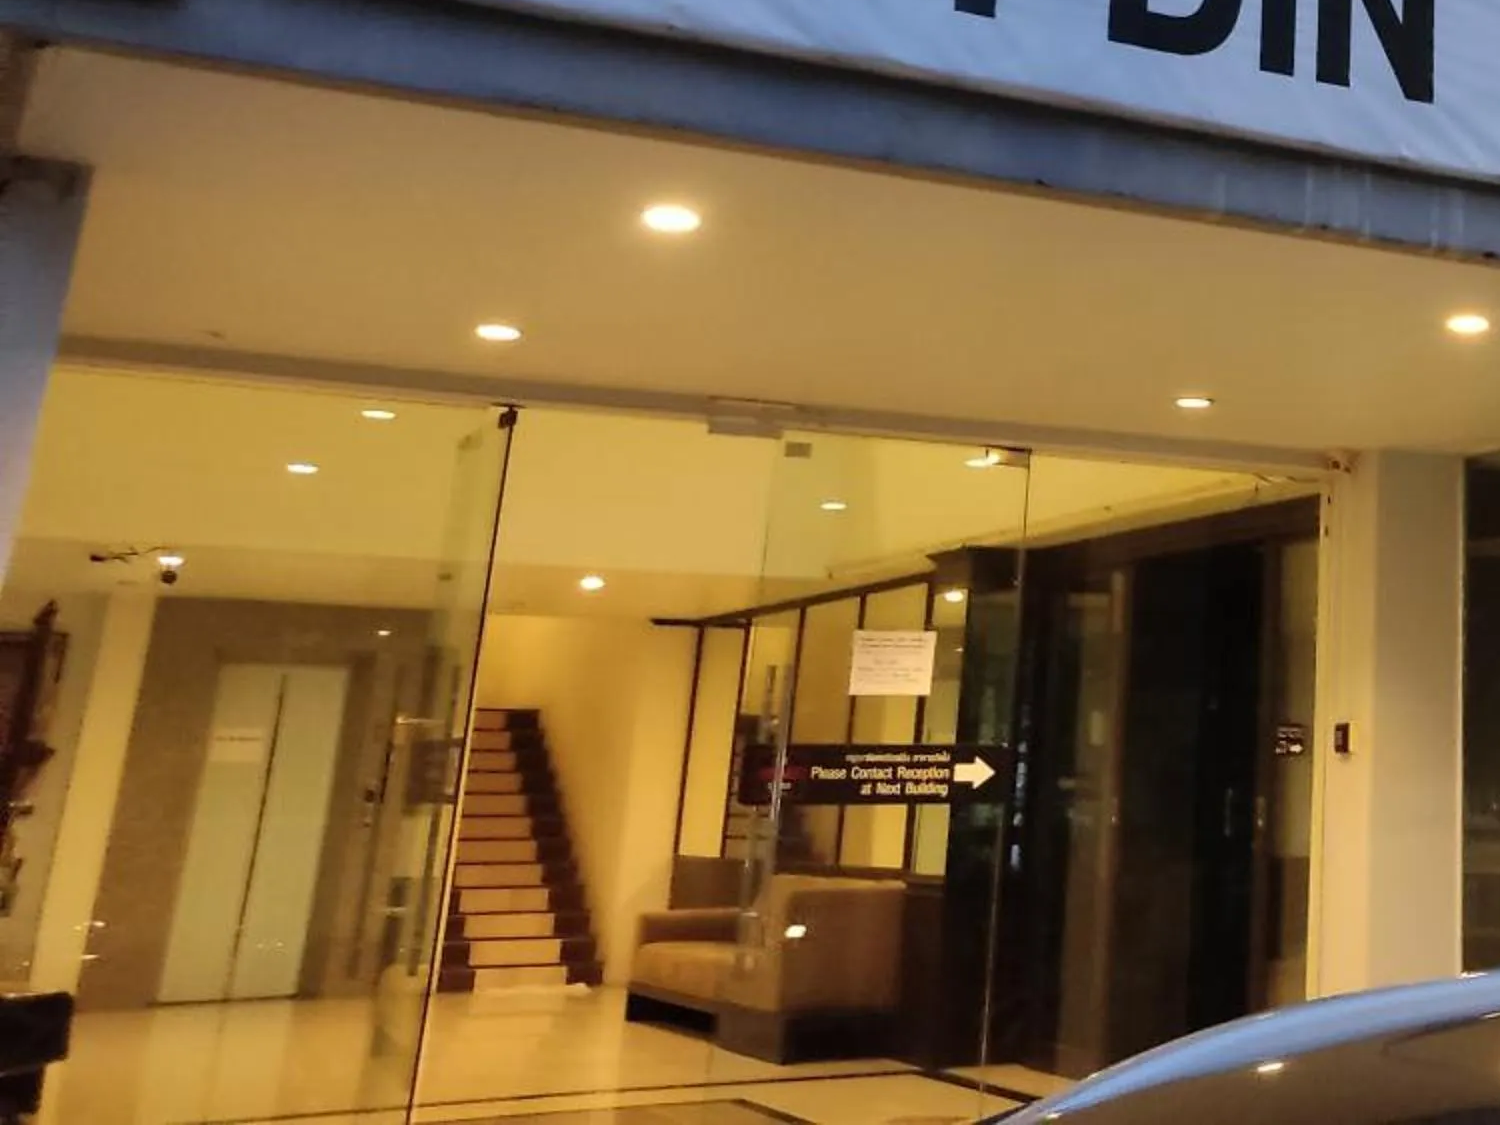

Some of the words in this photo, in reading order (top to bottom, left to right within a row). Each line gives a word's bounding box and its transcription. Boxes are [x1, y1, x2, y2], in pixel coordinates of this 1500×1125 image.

[811, 766, 847, 780] Please
[851, 766, 893, 780] Contact
[897, 766, 950, 782] Reception
[860, 783, 872, 795] at
[875, 782, 901, 795] Next
[905, 782, 949, 797] Building
